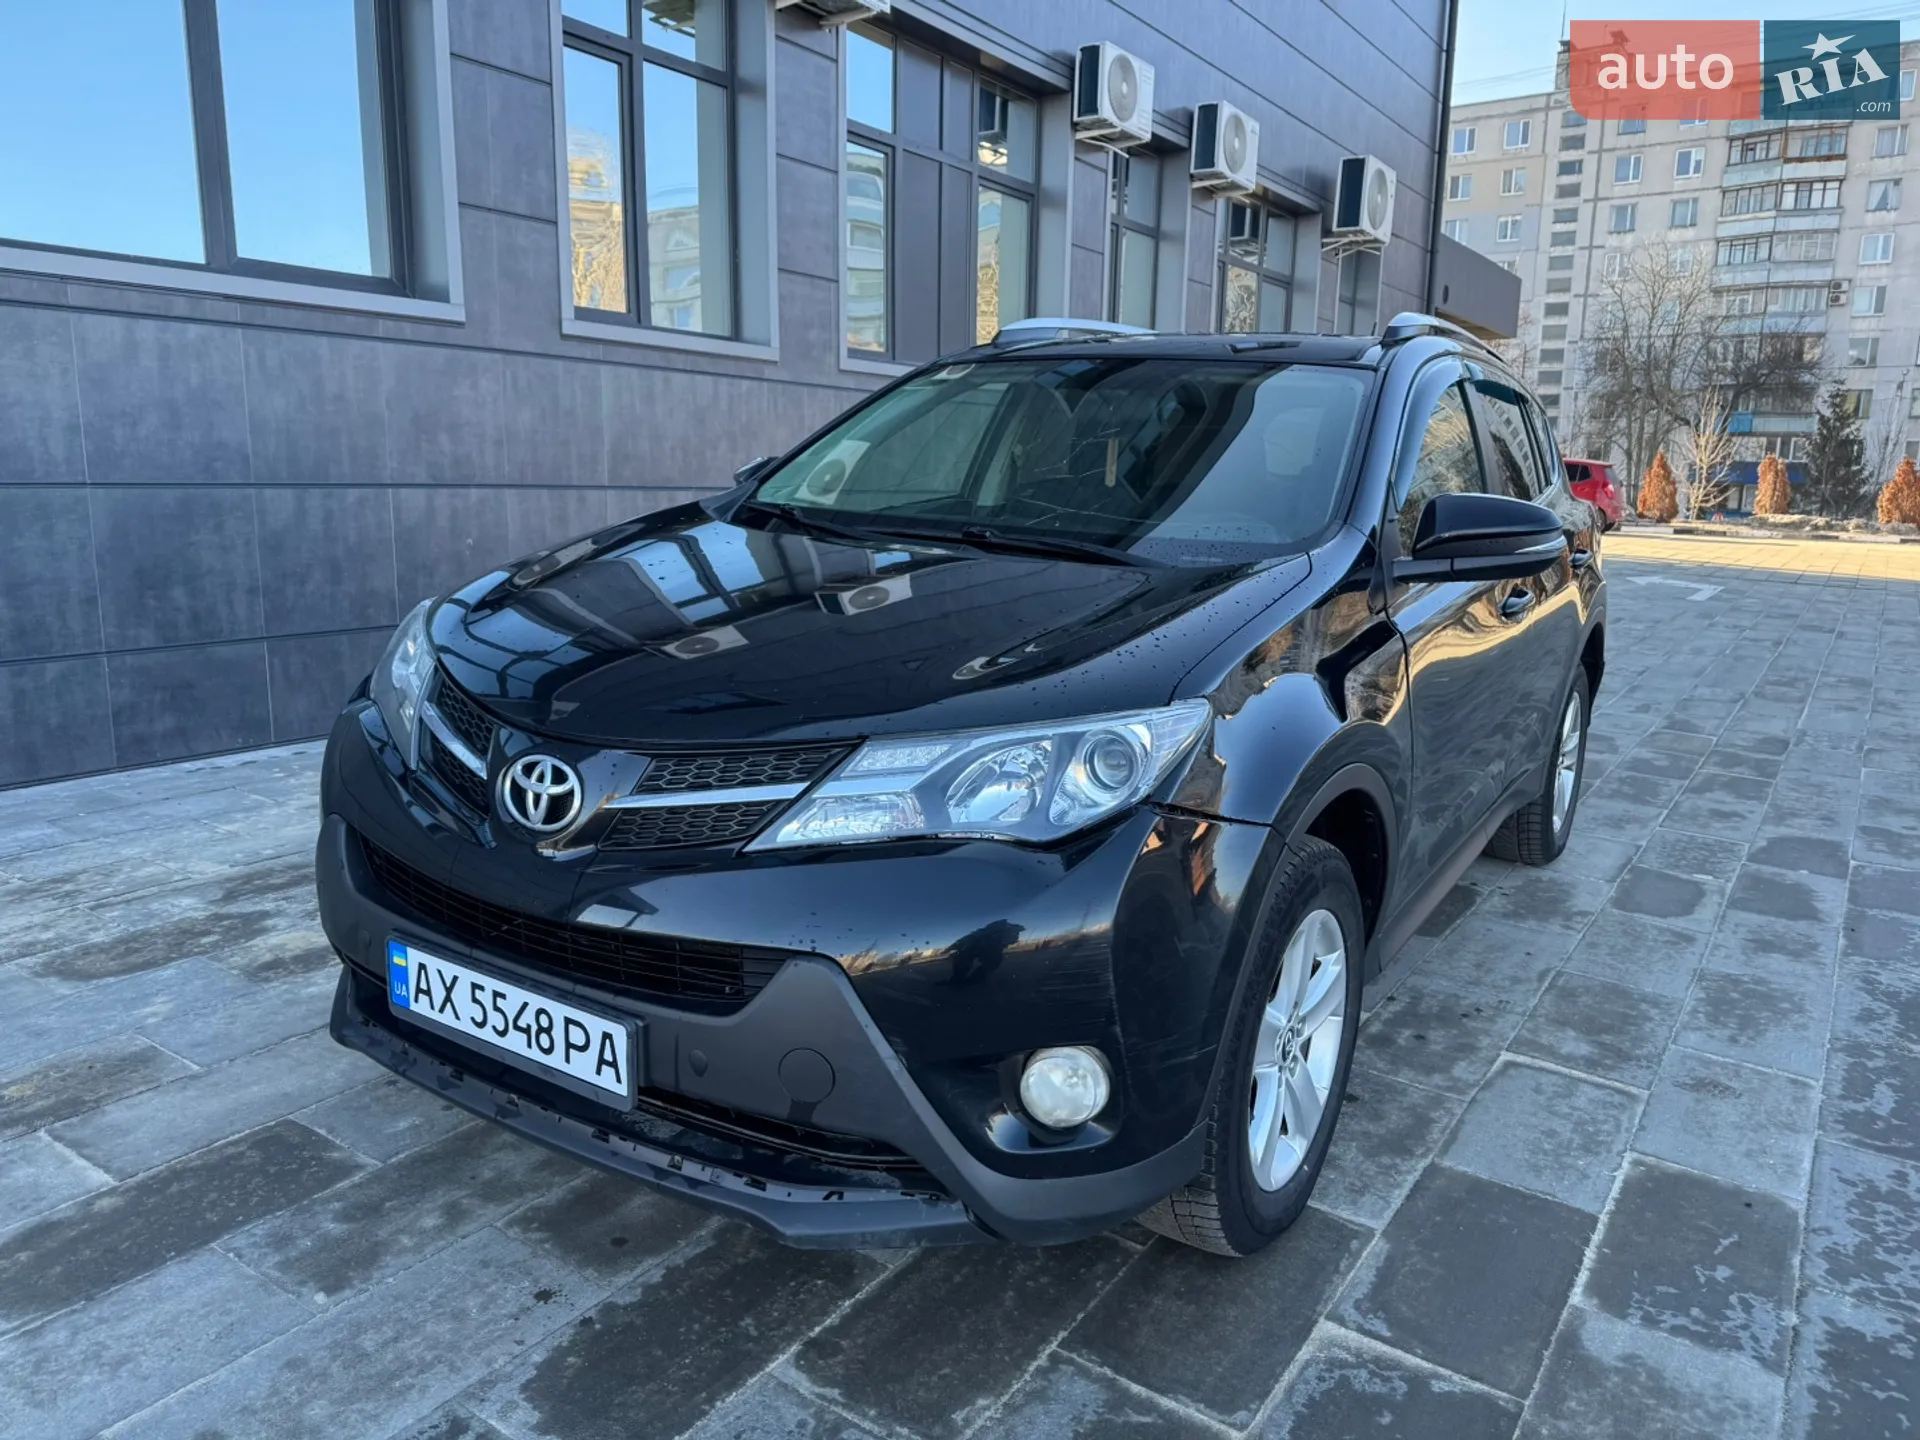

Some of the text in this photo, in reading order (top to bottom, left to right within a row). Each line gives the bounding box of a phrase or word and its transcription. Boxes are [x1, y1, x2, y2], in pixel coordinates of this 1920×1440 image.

[394, 981, 408, 998] UA
[414, 961, 622, 1085] AX 5548 PA
